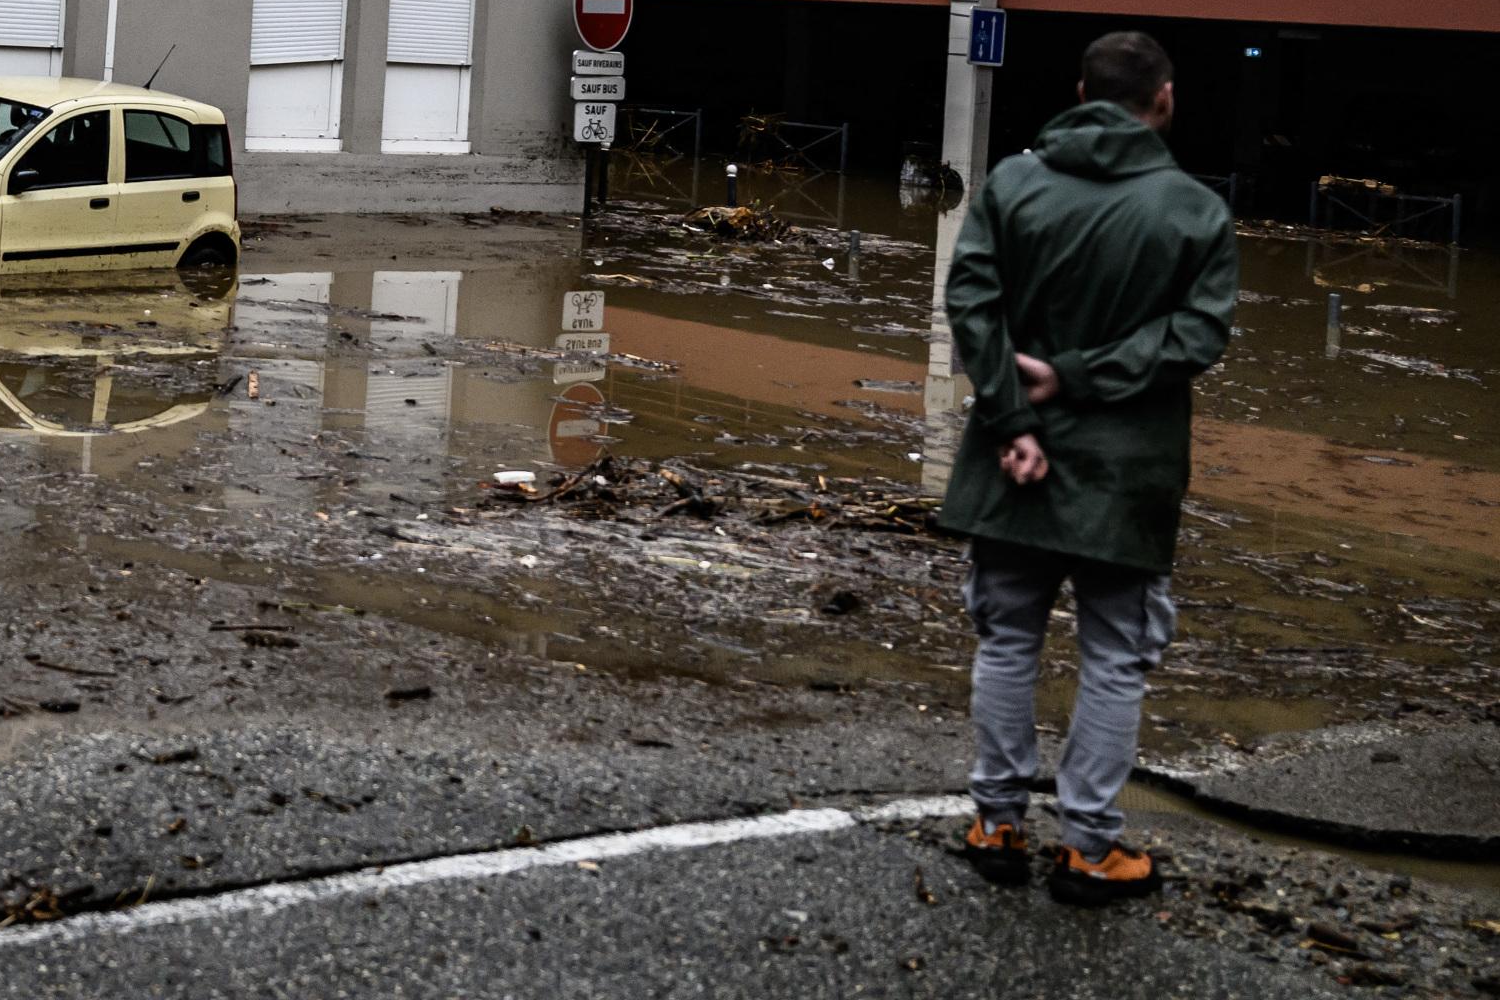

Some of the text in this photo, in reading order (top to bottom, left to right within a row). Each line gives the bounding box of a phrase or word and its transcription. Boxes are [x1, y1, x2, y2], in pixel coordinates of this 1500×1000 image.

[577, 58, 622, 68] SAUF RIVERAINS
[581, 84, 618, 94] SAUF BUS
[585, 105, 607, 115] SAUF
